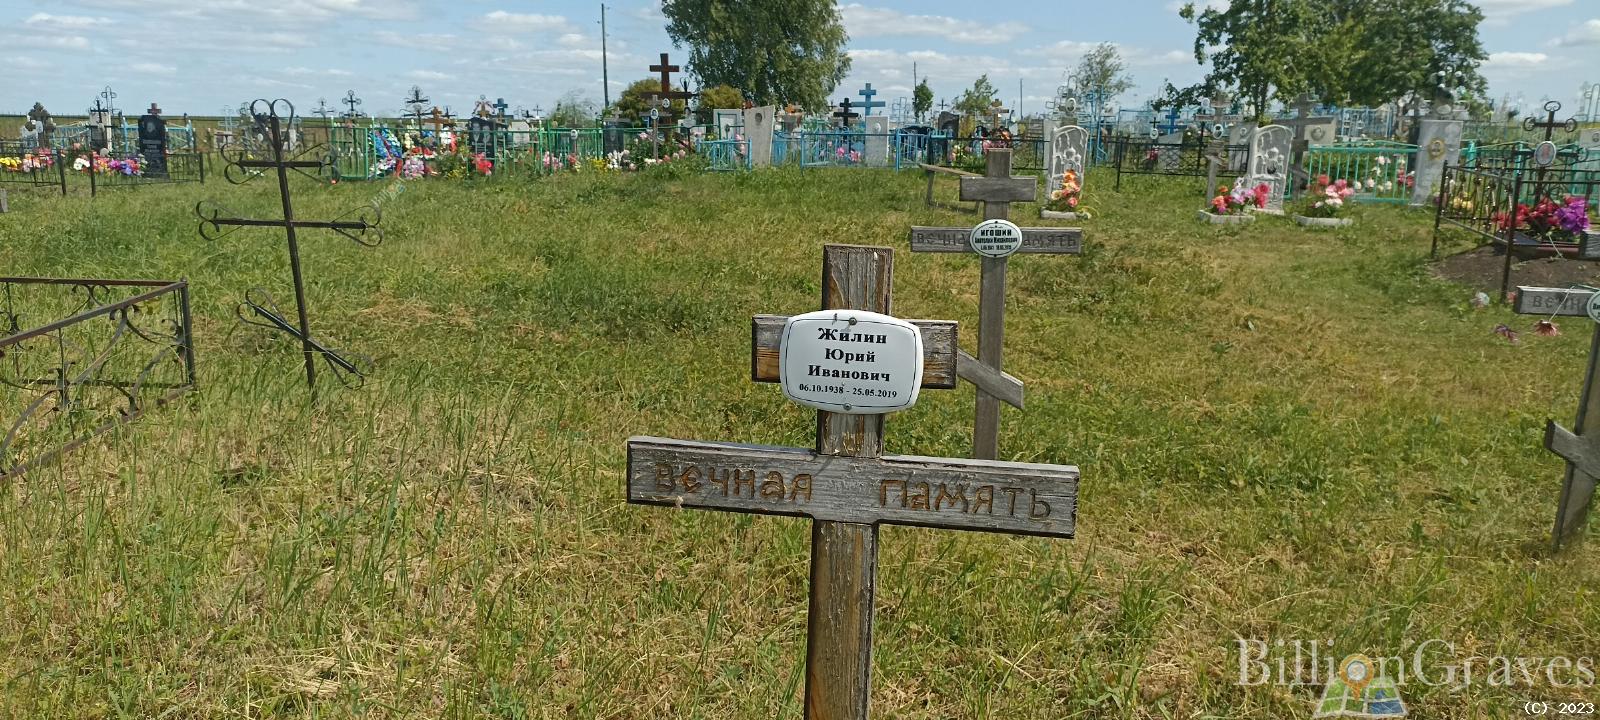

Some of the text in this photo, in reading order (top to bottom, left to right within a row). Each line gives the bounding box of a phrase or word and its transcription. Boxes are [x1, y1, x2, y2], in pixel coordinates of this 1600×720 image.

[817, 327, 887, 344] Жилин
[825, 348, 875, 364] Юрий
[808, 365, 890, 382] Иванович
[799, 383, 844, 394] 06.10.1938
[852, 387, 897, 398] 25.05.2019
